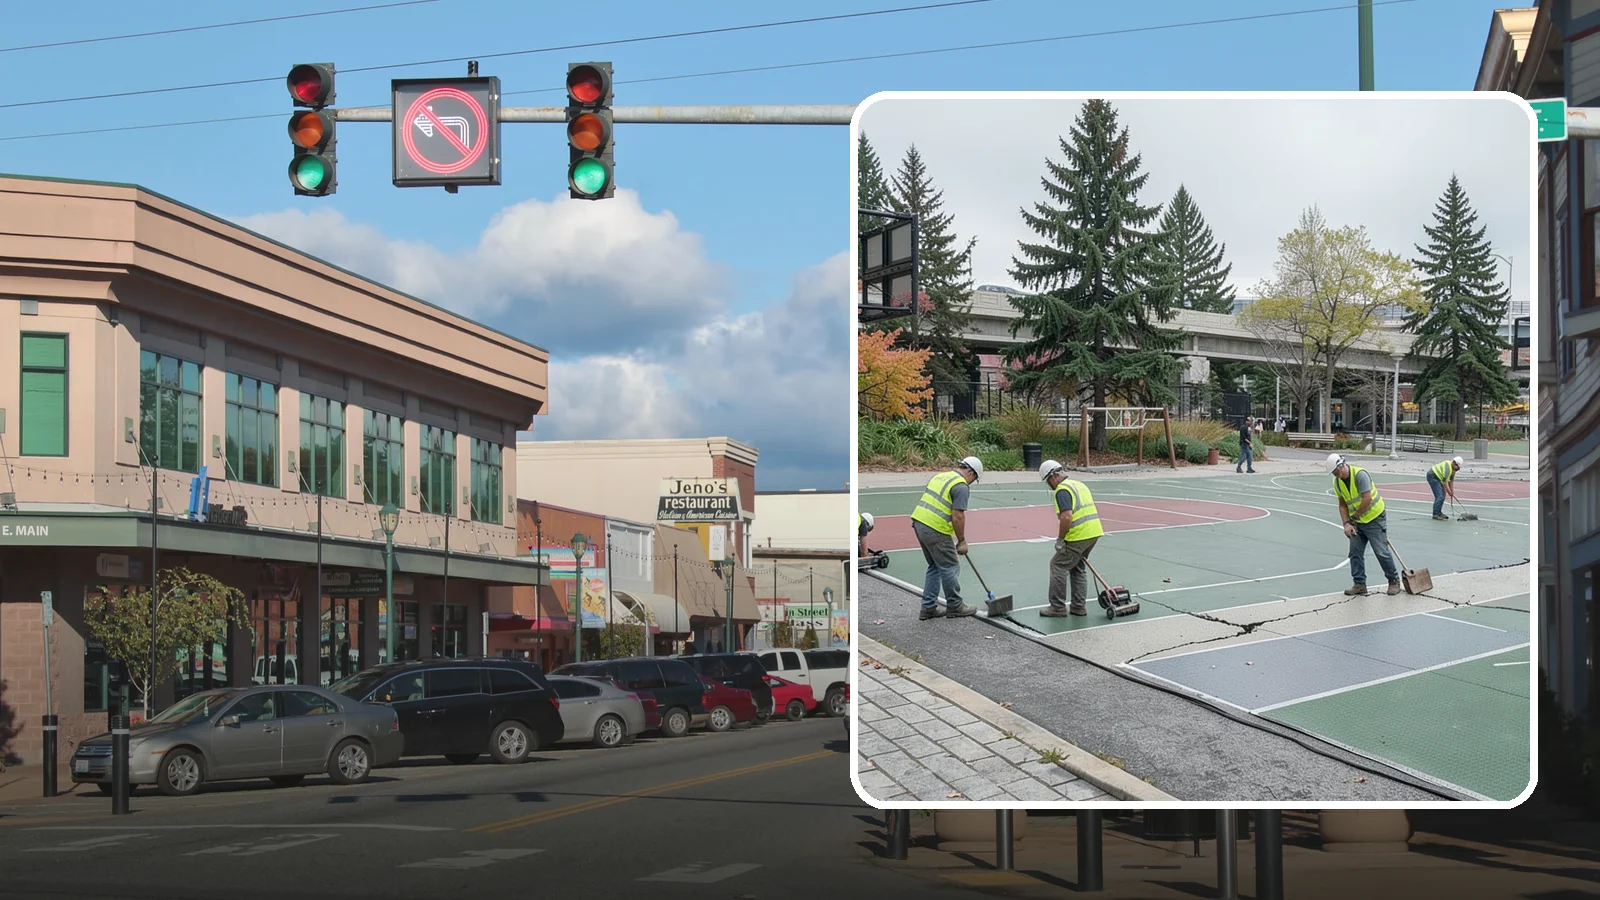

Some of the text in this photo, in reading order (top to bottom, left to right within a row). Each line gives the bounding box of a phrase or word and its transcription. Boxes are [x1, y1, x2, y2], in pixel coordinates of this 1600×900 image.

[669, 480, 728, 494] Jeno's
[665, 496, 731, 509] restaurant
[715, 510, 737, 519] Cuisine
[2, 525, 49, 536] E. MAIN
[797, 607, 828, 616] Street
